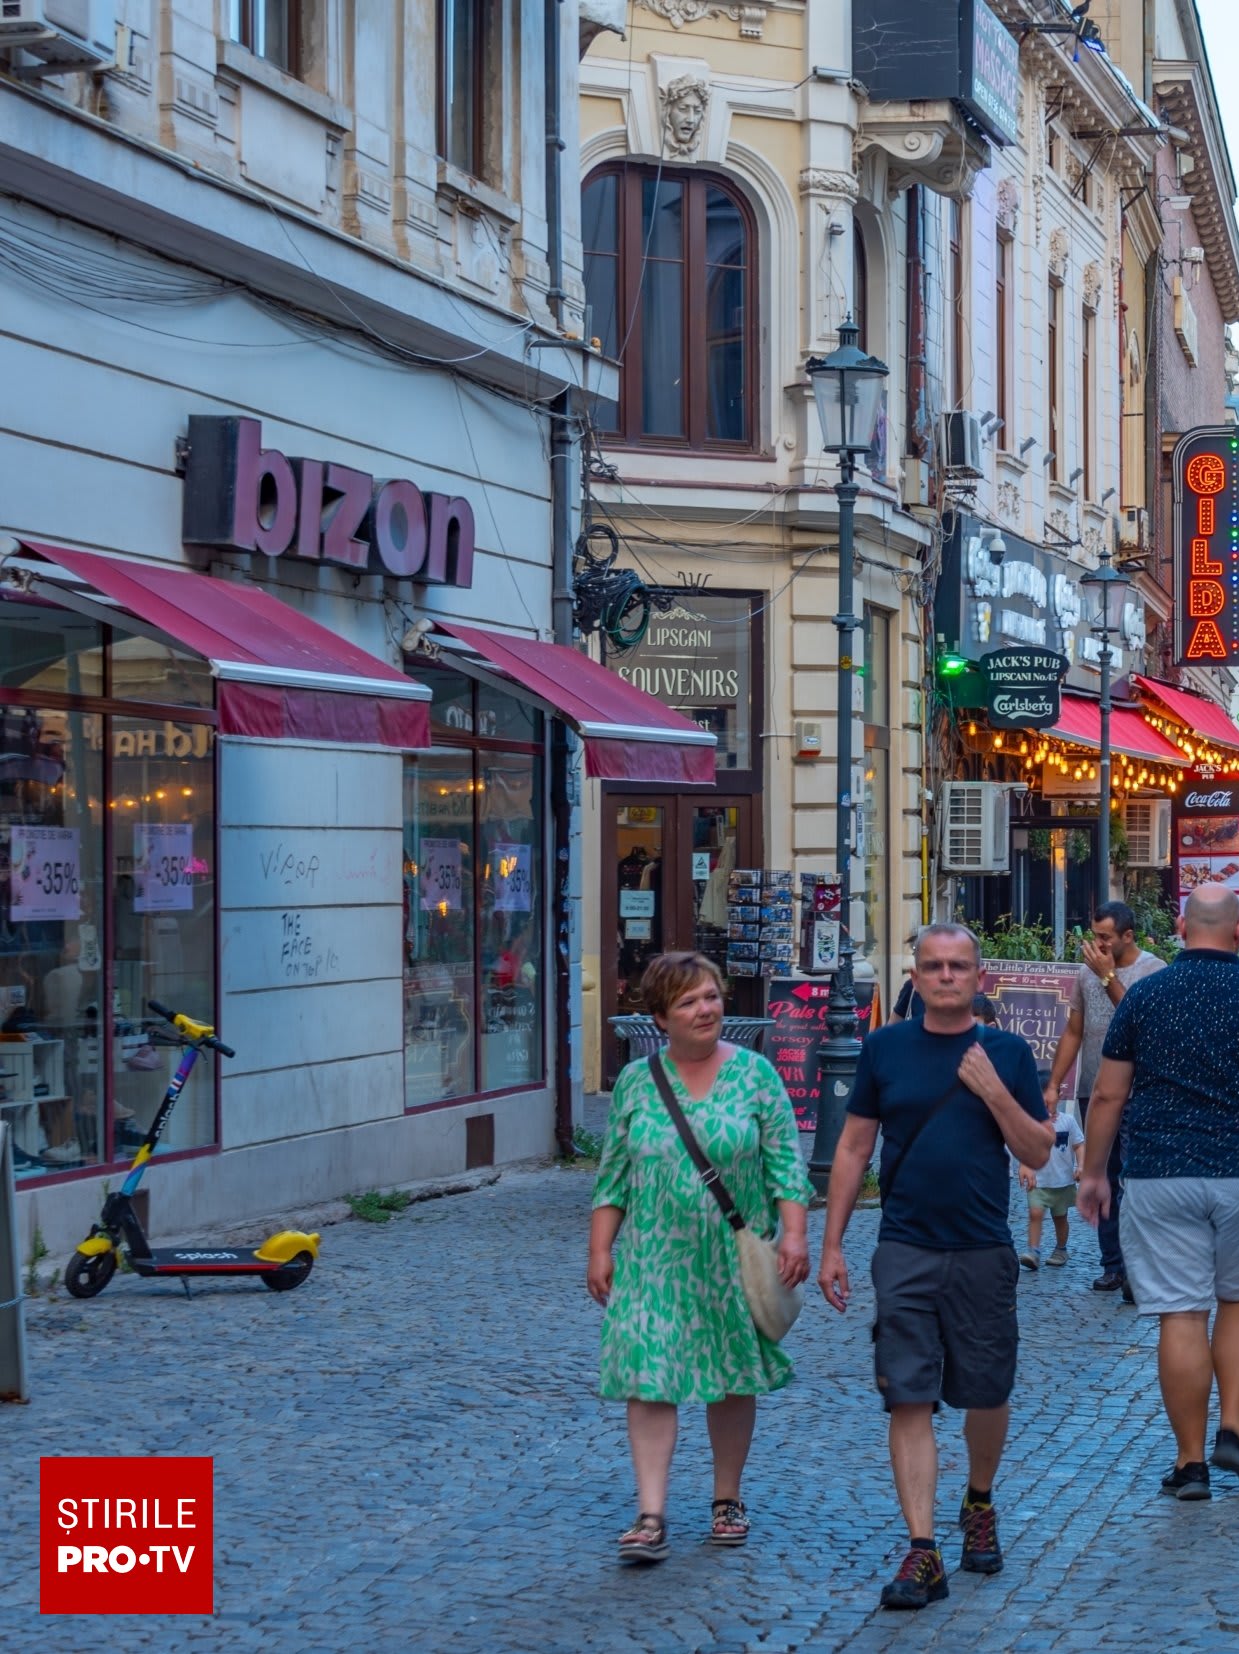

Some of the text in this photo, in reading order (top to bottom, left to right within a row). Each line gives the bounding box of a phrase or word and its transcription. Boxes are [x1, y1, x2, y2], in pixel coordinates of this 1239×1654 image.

[975, 4, 992, 36] HOT
[975, 33, 1017, 113] MASSAGE
[233, 418, 475, 589] bizon
[1187, 455, 1227, 658] GILDA
[647, 628, 711, 647] LIPSCANI
[987, 656, 1061, 670] JACK'S PUB
[618, 667, 738, 697] SOUVENIRS
[990, 672, 1031, 681] LIPSCANI
[993, 695, 1053, 717] Carlsberg
[1194, 764, 1221, 773] JACK'S
[1184, 791, 1233, 808] Coca-Cola
[37, 862, 79, 895] -35%
[156, 856, 193, 887] -35%
[281, 913, 300, 936] THE
[281, 937, 312, 963] FACE
[983, 961, 998, 971] The
[1000, 963, 1022, 972] Little
[1024, 964, 1044, 973] Paris
[811, 988, 817, 996] 8
[999, 1003, 1057, 1017] Muzeul
[771, 1035, 815, 1047] orsay
[174, 1251, 239, 1262] splash
